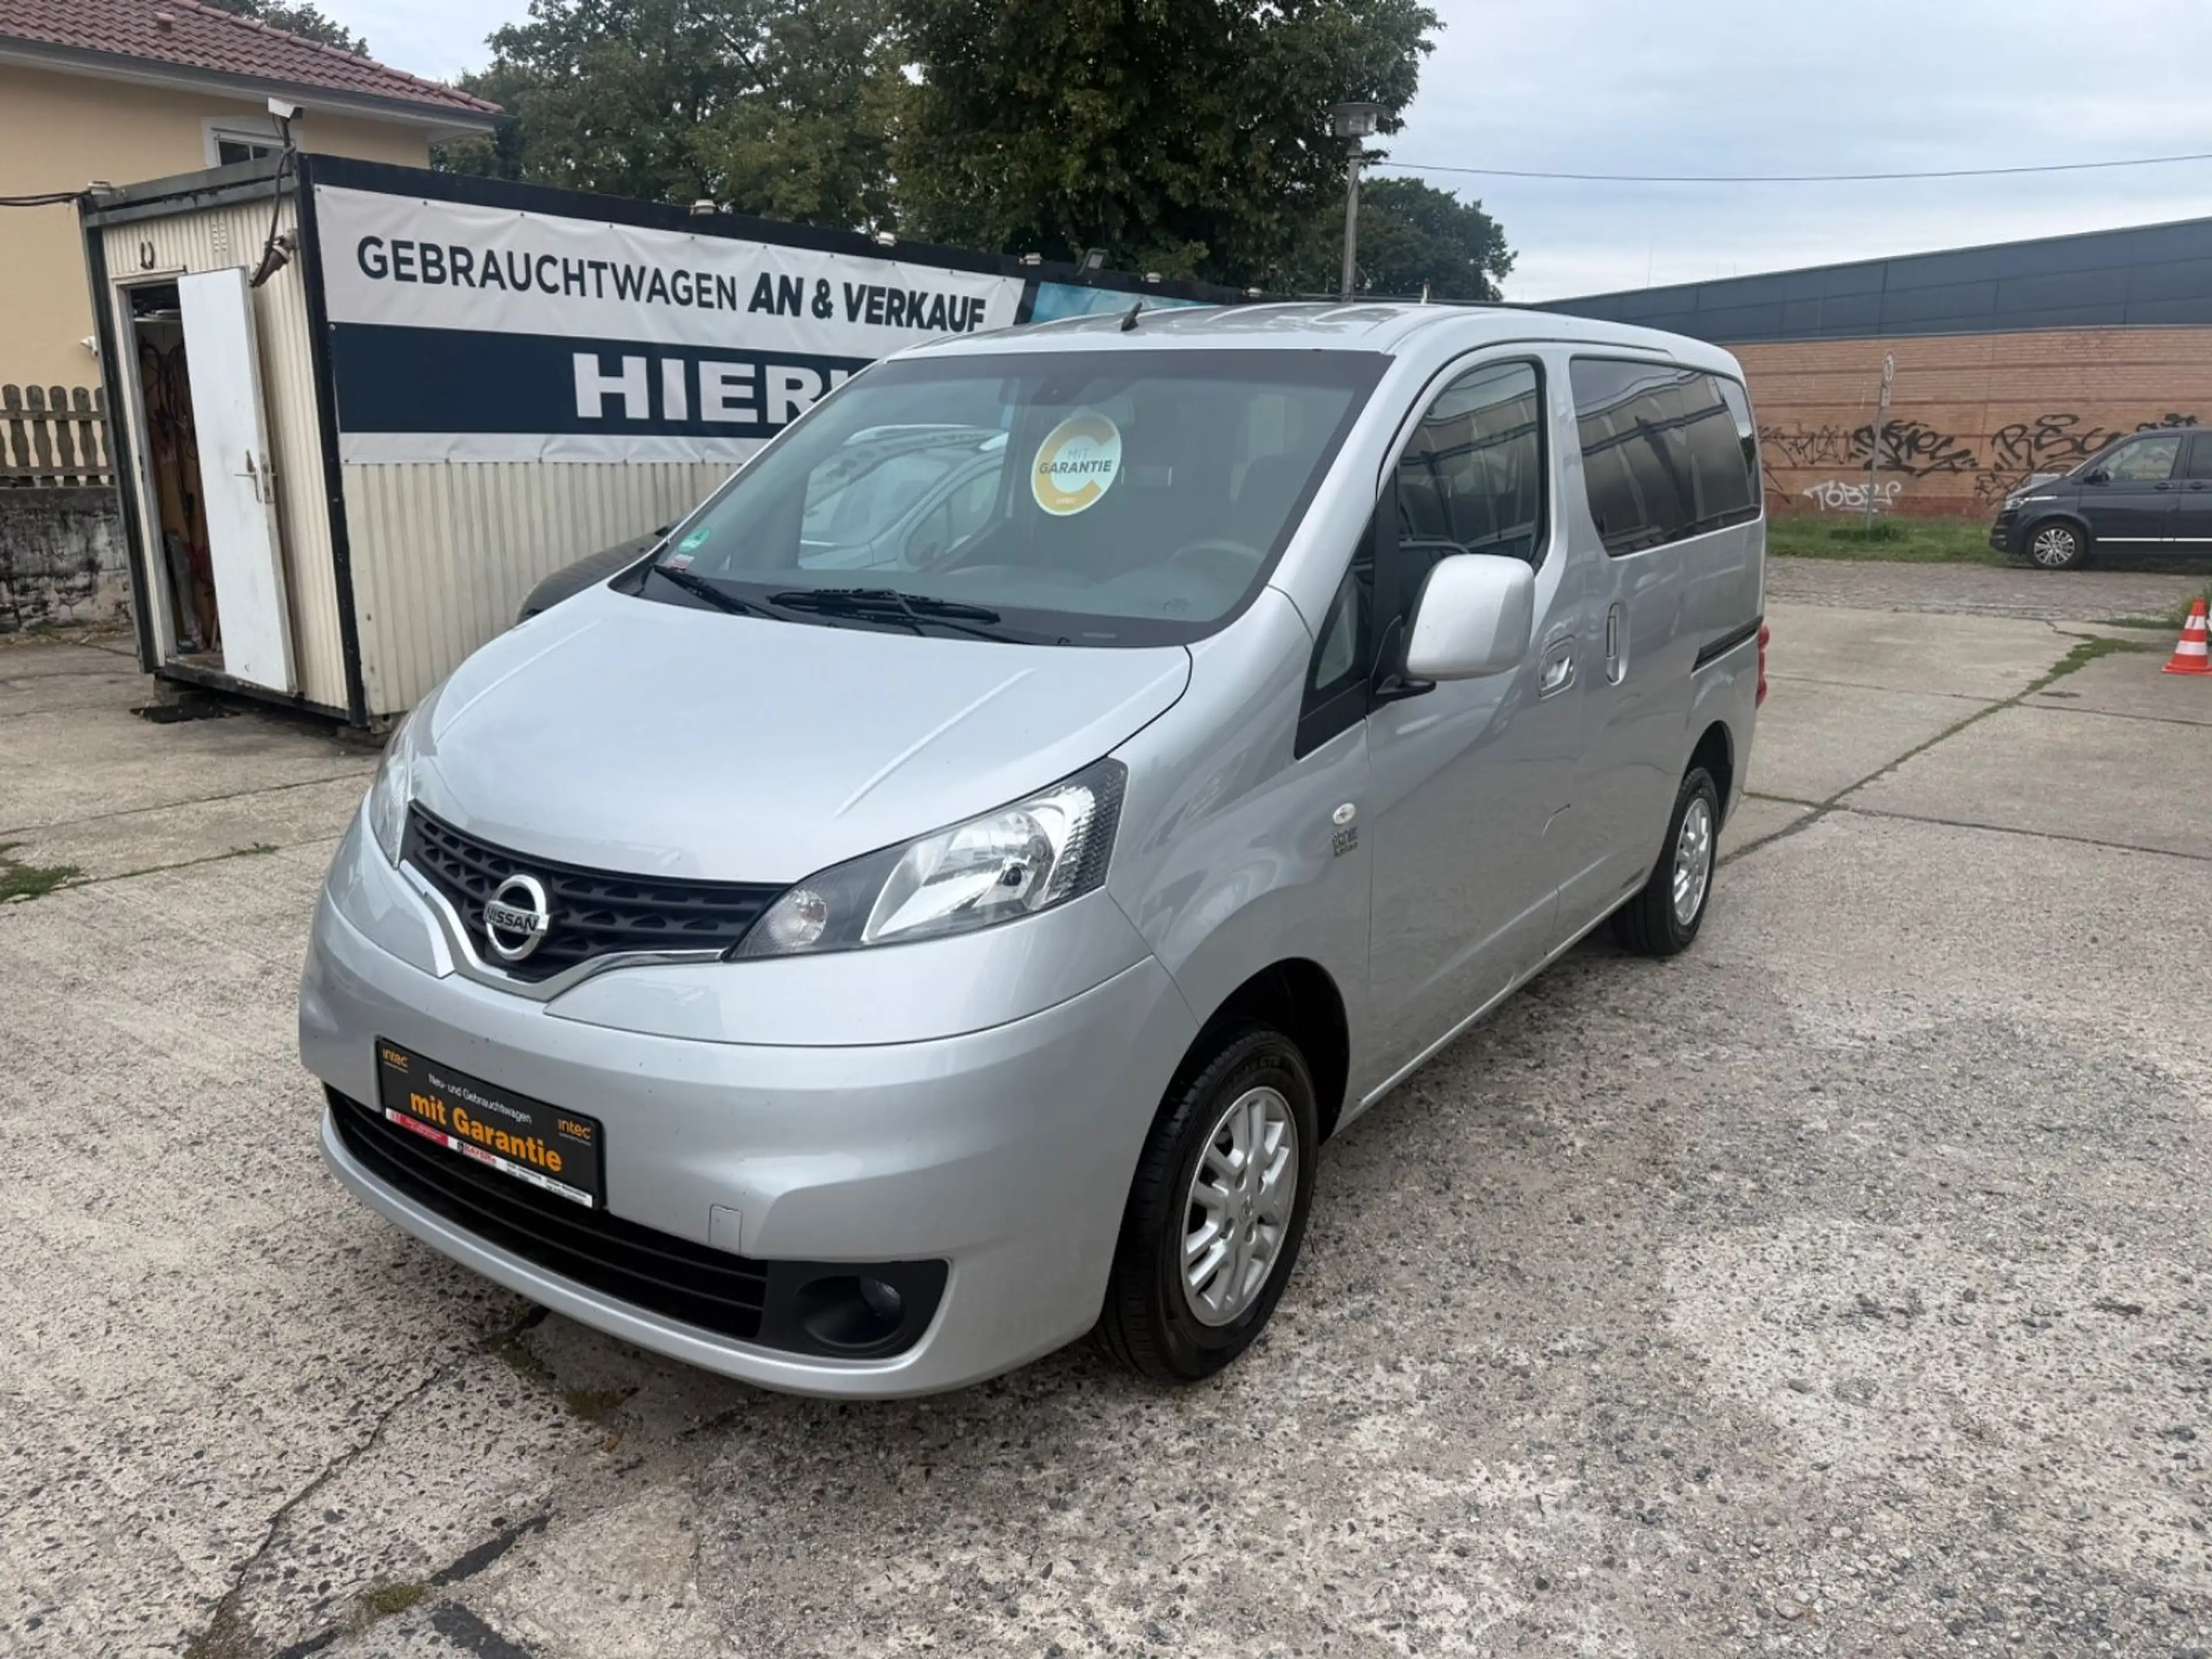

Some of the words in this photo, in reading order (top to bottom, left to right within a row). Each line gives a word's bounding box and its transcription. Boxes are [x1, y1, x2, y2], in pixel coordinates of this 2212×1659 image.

[358, 236, 737, 311] GEBRAUCHTWAGEN
[748, 272, 804, 317] AN
[812, 278, 833, 319] &
[844, 282, 986, 332] VERKAUF
[573, 353, 848, 424] HIER
[1039, 460, 1113, 475] GARANTIE
[487, 907, 538, 931] NISSAN
[410, 1092, 446, 1125] mit
[453, 1107, 563, 1172] Garantie
[558, 1119, 592, 1140] intec
